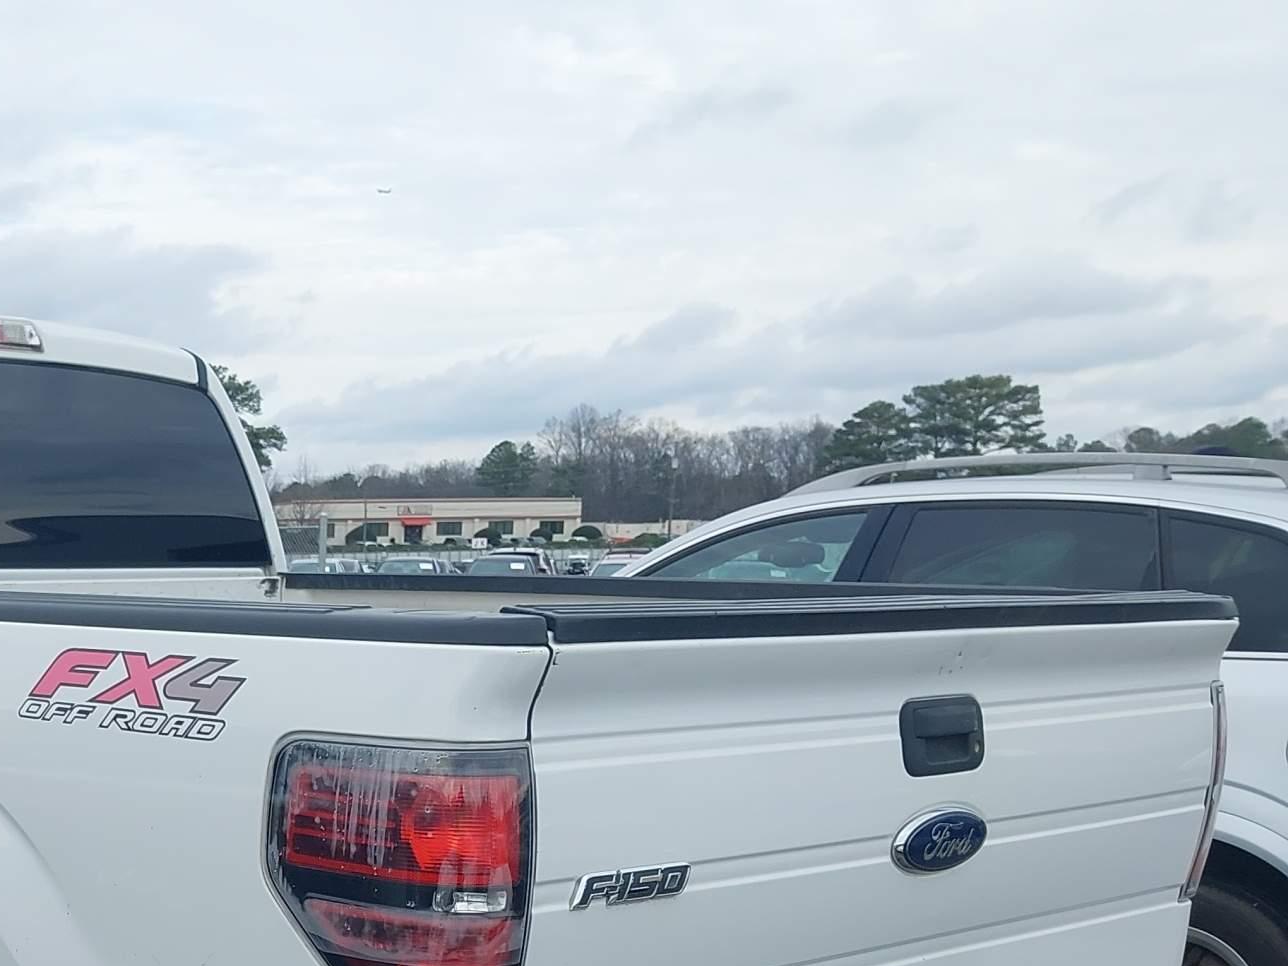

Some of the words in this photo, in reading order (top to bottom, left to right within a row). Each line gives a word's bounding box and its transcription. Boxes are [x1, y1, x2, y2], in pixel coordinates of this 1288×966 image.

[28, 648, 247, 716] FX4
[18, 698, 96, 724] OFF
[98, 707, 227, 741] ROAD
[923, 822, 975, 860] Ford
